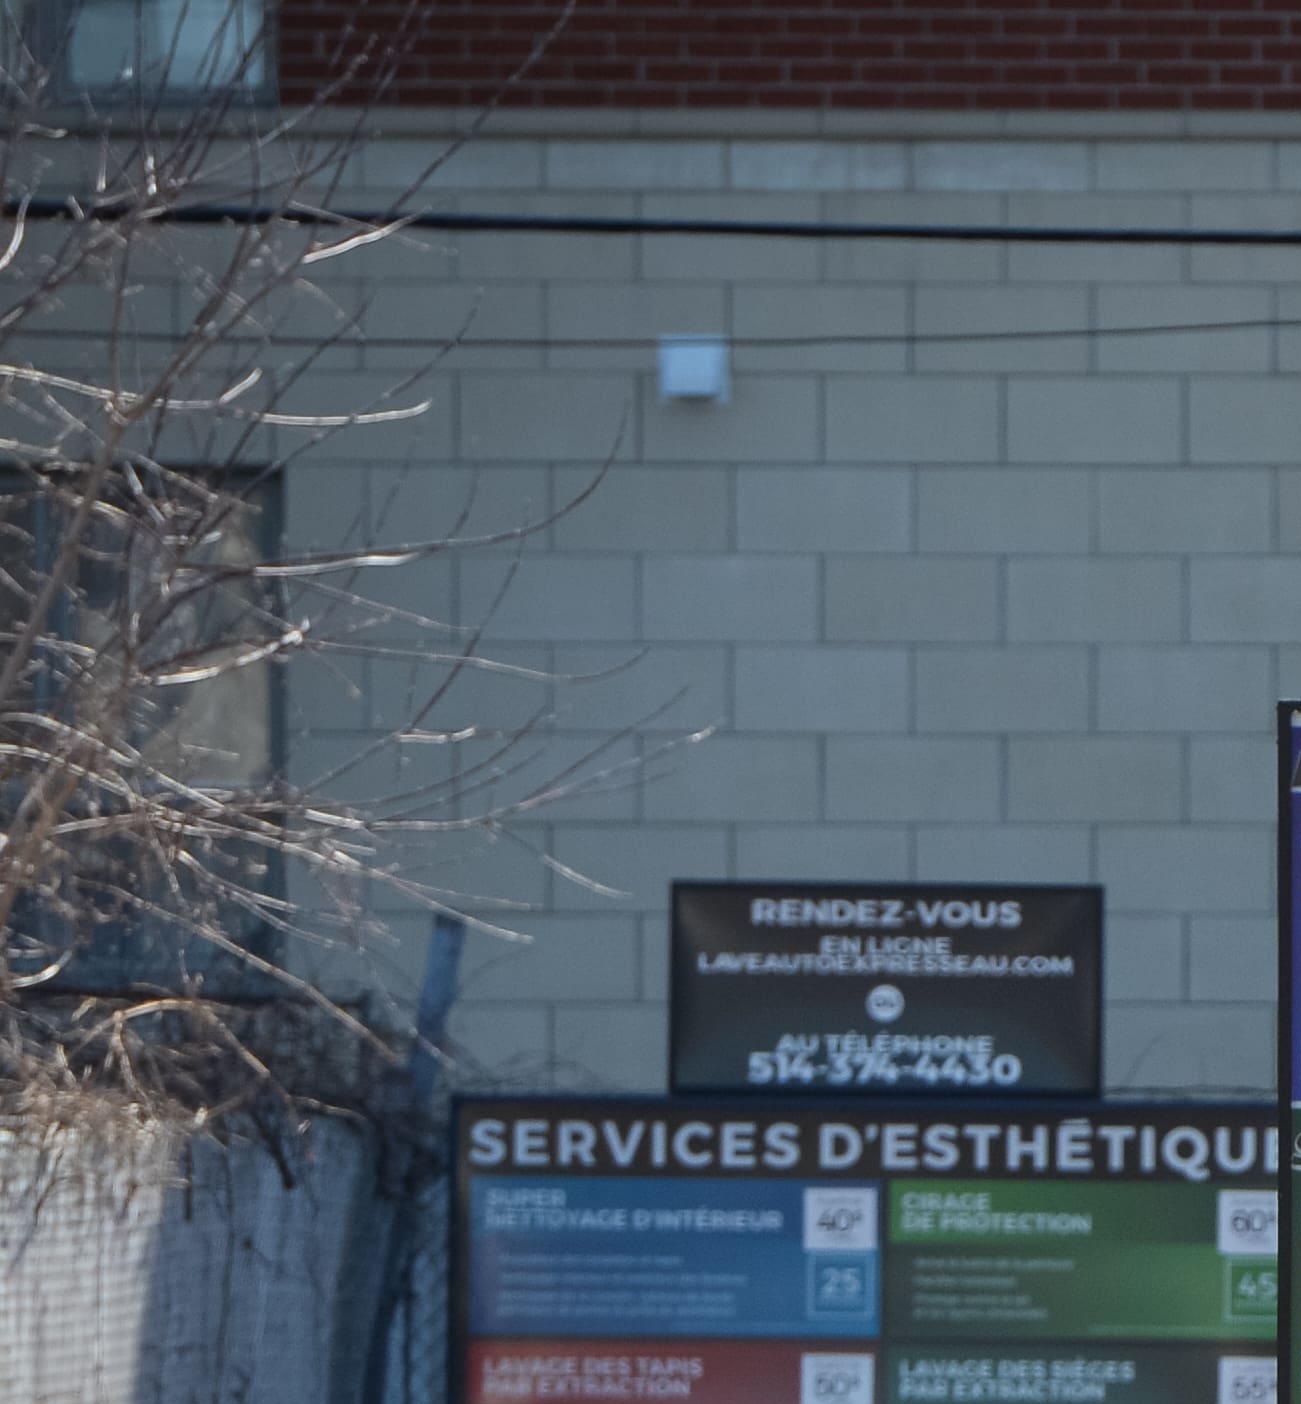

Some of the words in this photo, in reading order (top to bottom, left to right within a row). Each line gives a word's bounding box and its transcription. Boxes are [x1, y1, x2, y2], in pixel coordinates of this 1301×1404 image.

[751, 897, 1022, 927] RENDEZ-VOUS
[820, 935, 861, 954] EN
[868, 936, 952, 955] LIGNE
[777, 1033, 818, 1053] AU
[469, 1119, 800, 1169] SERVICES
